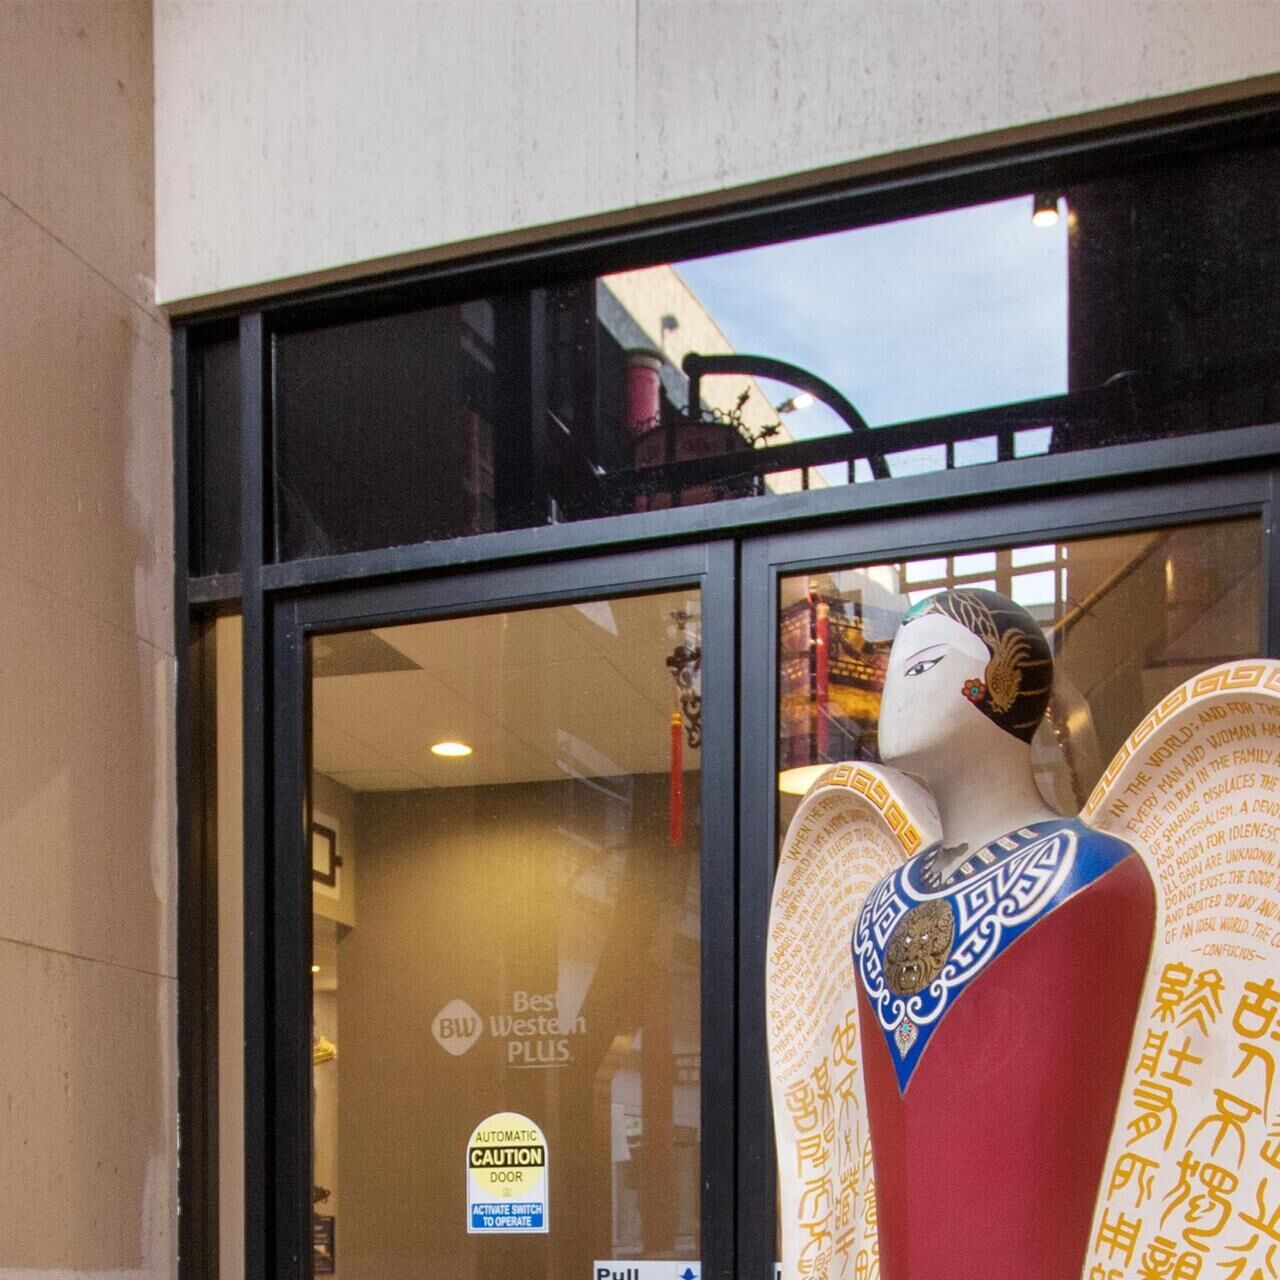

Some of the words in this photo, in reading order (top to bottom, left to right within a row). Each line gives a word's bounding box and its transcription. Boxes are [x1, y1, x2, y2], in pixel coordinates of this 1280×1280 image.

[1110, 799, 1128, 818] IN
[1124, 771, 1151, 796] THE
[1198, 706, 1228, 726] AND
[1226, 702, 1254, 714] FOR
[1126, 792, 1159, 834] EVERY
[1158, 767, 1185, 794] MAN
[1182, 746, 1206, 772] AND
[1206, 723, 1256, 749] WOMAN
[1139, 815, 1163, 843] ROLE
[1163, 801, 1176, 815] TO
[1175, 779, 1197, 803] PLAY
[1196, 768, 1210, 783] IN
[1209, 755, 1230, 772] THE
[1233, 748, 1272, 765] FAMILY
[805, 806, 823, 825] THE
[1149, 841, 1162, 855] OF
[1162, 801, 1200, 842] SHARING
[1203, 773, 1256, 803] DISPLACES
[1156, 846, 1175, 868] AND
[1240, 800, 1248, 814] A
[1159, 865, 1175, 882] NO
[1175, 841, 1204, 869] ROOM
[1206, 831, 1226, 849] FOR
[1163, 879, 1178, 896] ILL
[1179, 863, 1203, 885] GAIN
[1205, 853, 1222, 869] ARE
[1165, 894, 1179, 910] DO
[1178, 882, 1197, 900] NOT
[1228, 871, 1245, 885] THE
[1248, 870, 1275, 888] DOOR
[1165, 908, 1183, 926] AND
[1186, 894, 1221, 917] BOLTED
[1224, 893, 1240, 907] BY
[1238, 895, 1258, 910] DAY
[1255, 899, 1279, 918] AND
[1165, 928, 1177, 944] OF
[1180, 922, 1193, 938] AN
[1195, 917, 1217, 933] IDEAL
[1251, 922, 1272, 941] THE
[439, 1018, 476, 1040] BW
[508, 1039, 570, 1063] PLUS
[475, 1130, 537, 1143] AUTOMATIC
[471, 1149, 542, 1166] CAUTION
[490, 1172, 523, 1183] DOOR
[472, 1204, 511, 1216] ACTIVATE
[511, 1203, 543, 1214] SWITCH
[483, 1216, 495, 1227] TO
[495, 1215, 532, 1227] OPERATE
